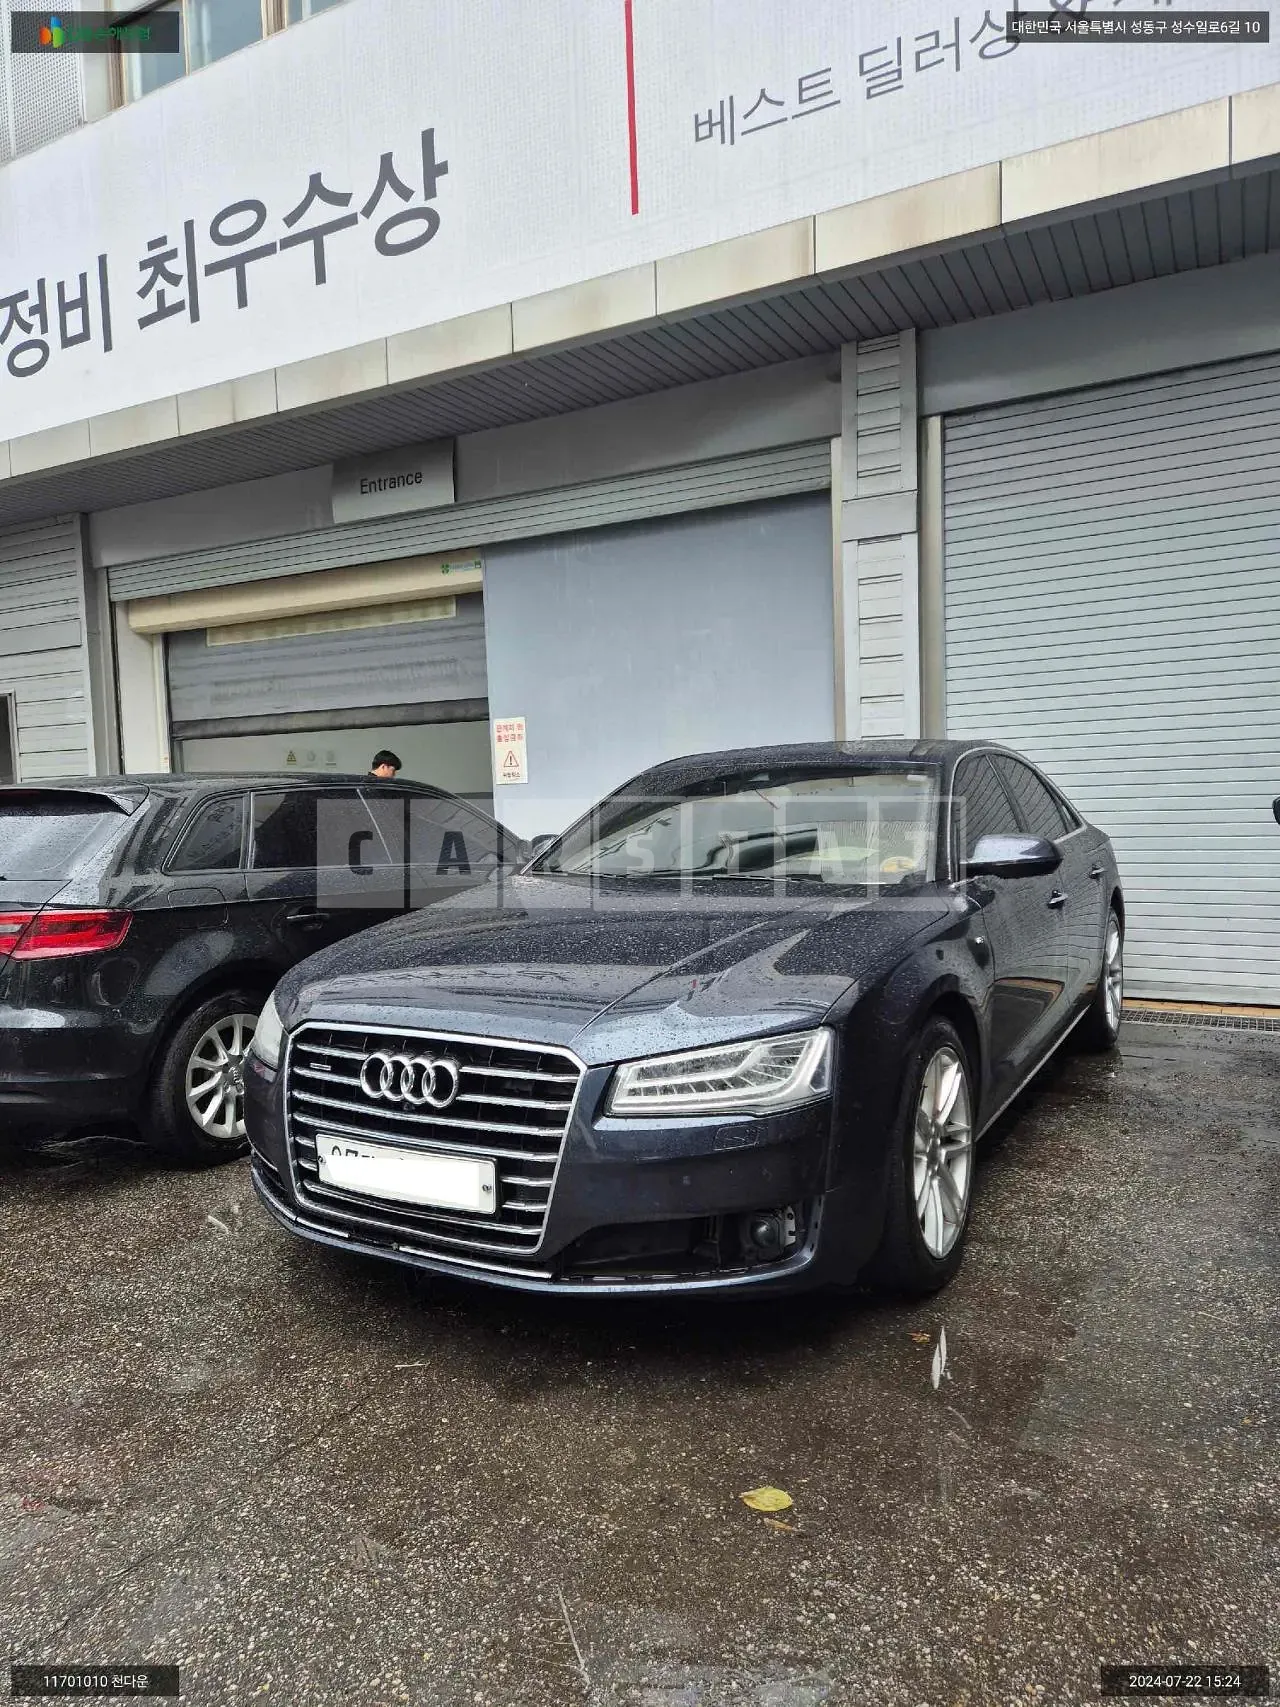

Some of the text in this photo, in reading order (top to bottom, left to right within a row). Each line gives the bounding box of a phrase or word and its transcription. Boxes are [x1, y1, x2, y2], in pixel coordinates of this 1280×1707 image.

[693, 67, 841, 145] 베스트
[859, 0, 1026, 99] 딜러상
[0, 128, 448, 377] 정비 최우수상
[360, 471, 423, 494] Entrance
